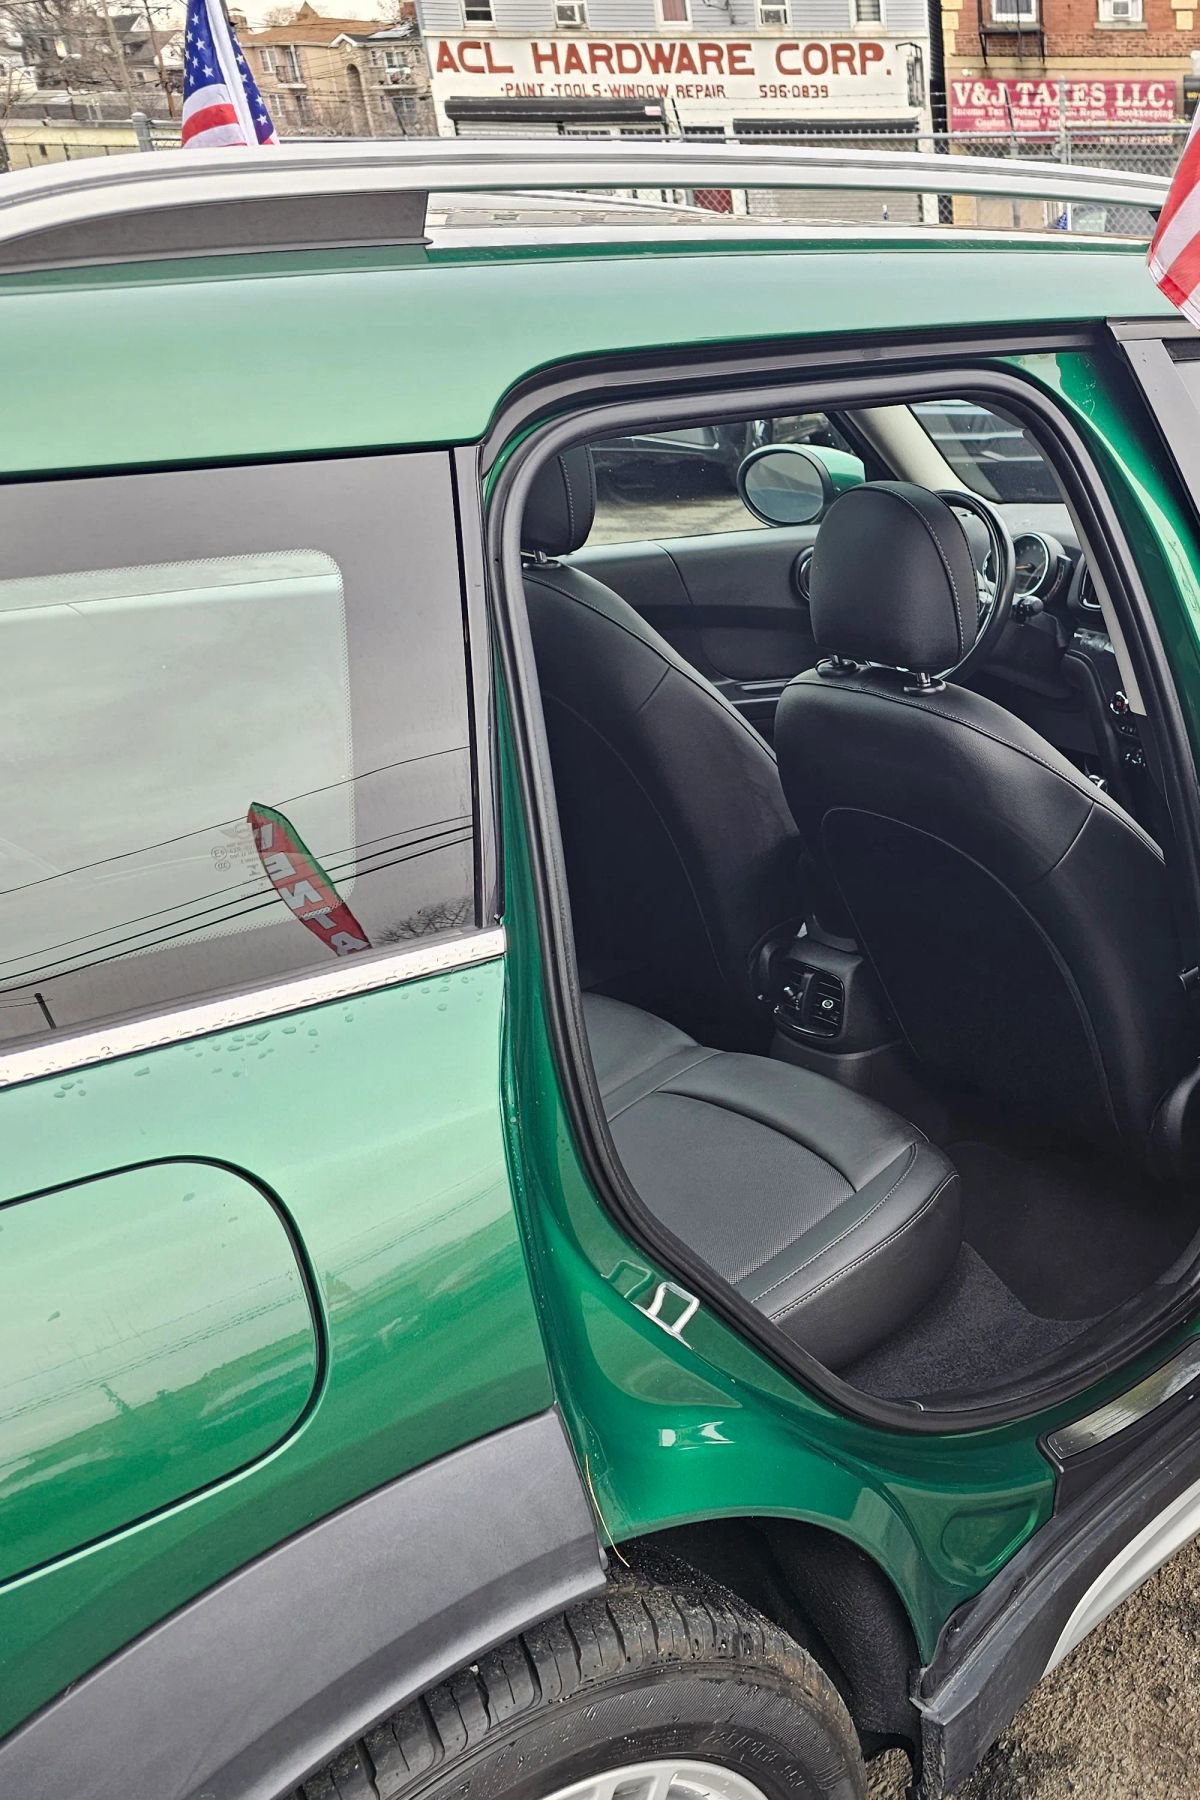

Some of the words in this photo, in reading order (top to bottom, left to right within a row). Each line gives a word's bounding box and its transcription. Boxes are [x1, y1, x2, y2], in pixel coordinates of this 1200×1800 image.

[436, 41, 514, 74] ACL
[531, 42, 755, 76] HARDWARE
[775, 42, 892, 76] CORP.
[676, 85, 726, 99] REPAIR
[952, 82, 1006, 107] V&J
[1016, 82, 1107, 108] TAXES
[1114, 83, 1174, 108] LLC.
